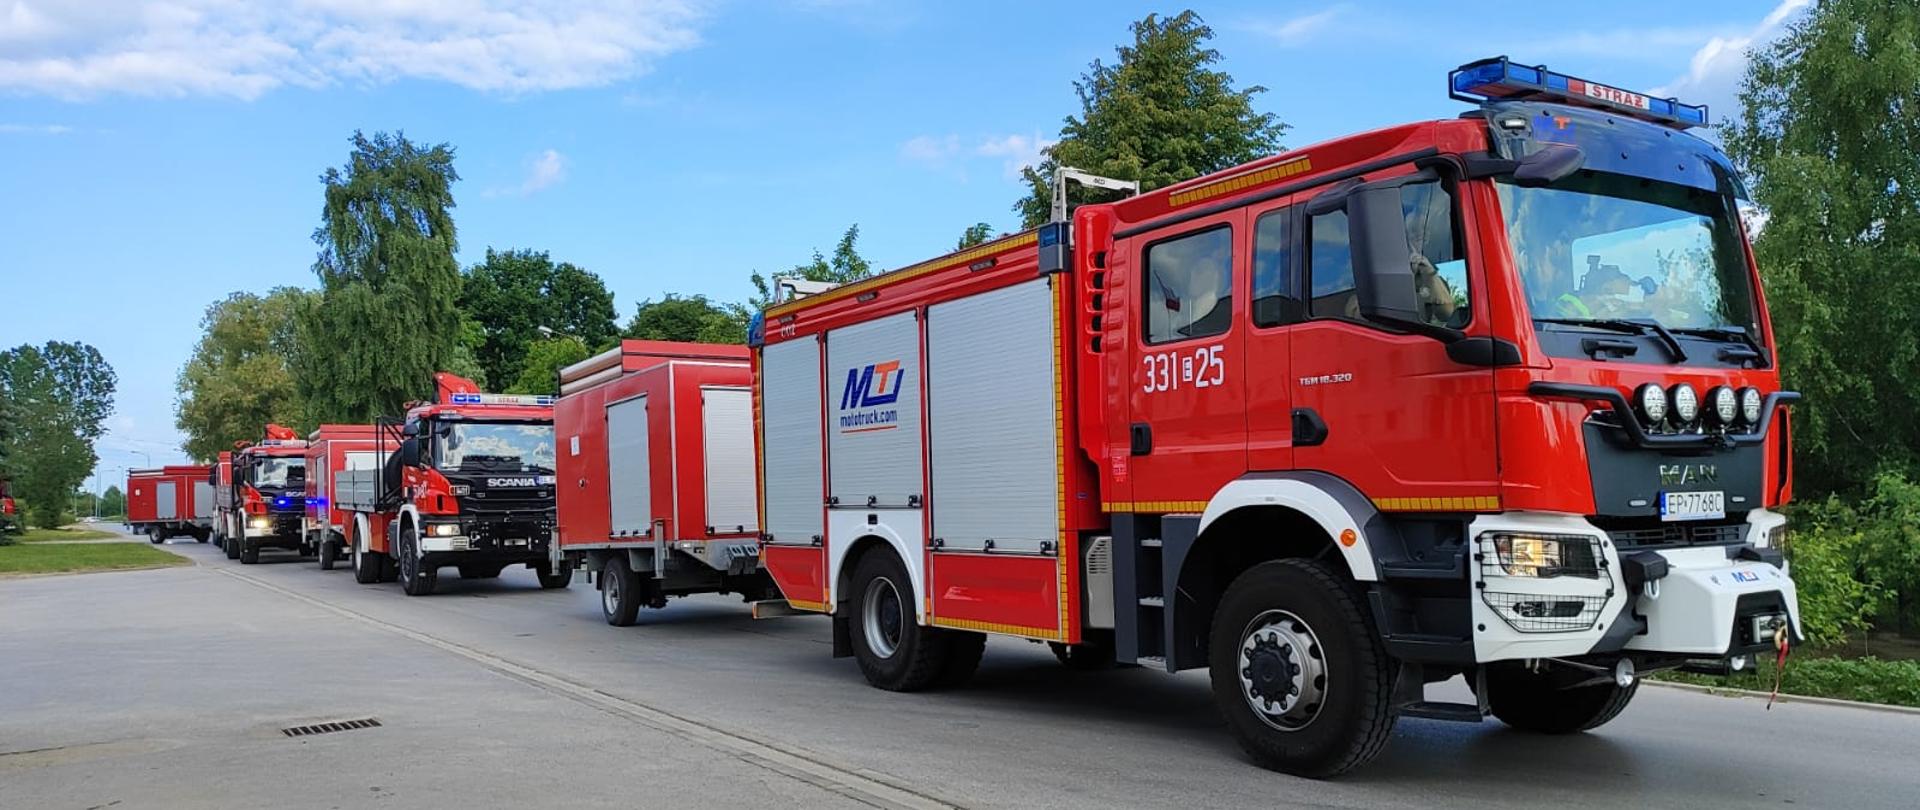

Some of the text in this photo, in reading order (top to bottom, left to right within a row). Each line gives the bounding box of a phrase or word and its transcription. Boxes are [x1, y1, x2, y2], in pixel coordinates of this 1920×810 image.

[1143, 351, 1178, 393] 331
[1195, 345, 1224, 388] 25
[840, 410, 898, 427] mototruck.com
[487, 478, 537, 487] SCANIA
[1660, 465, 1716, 485] MAN
